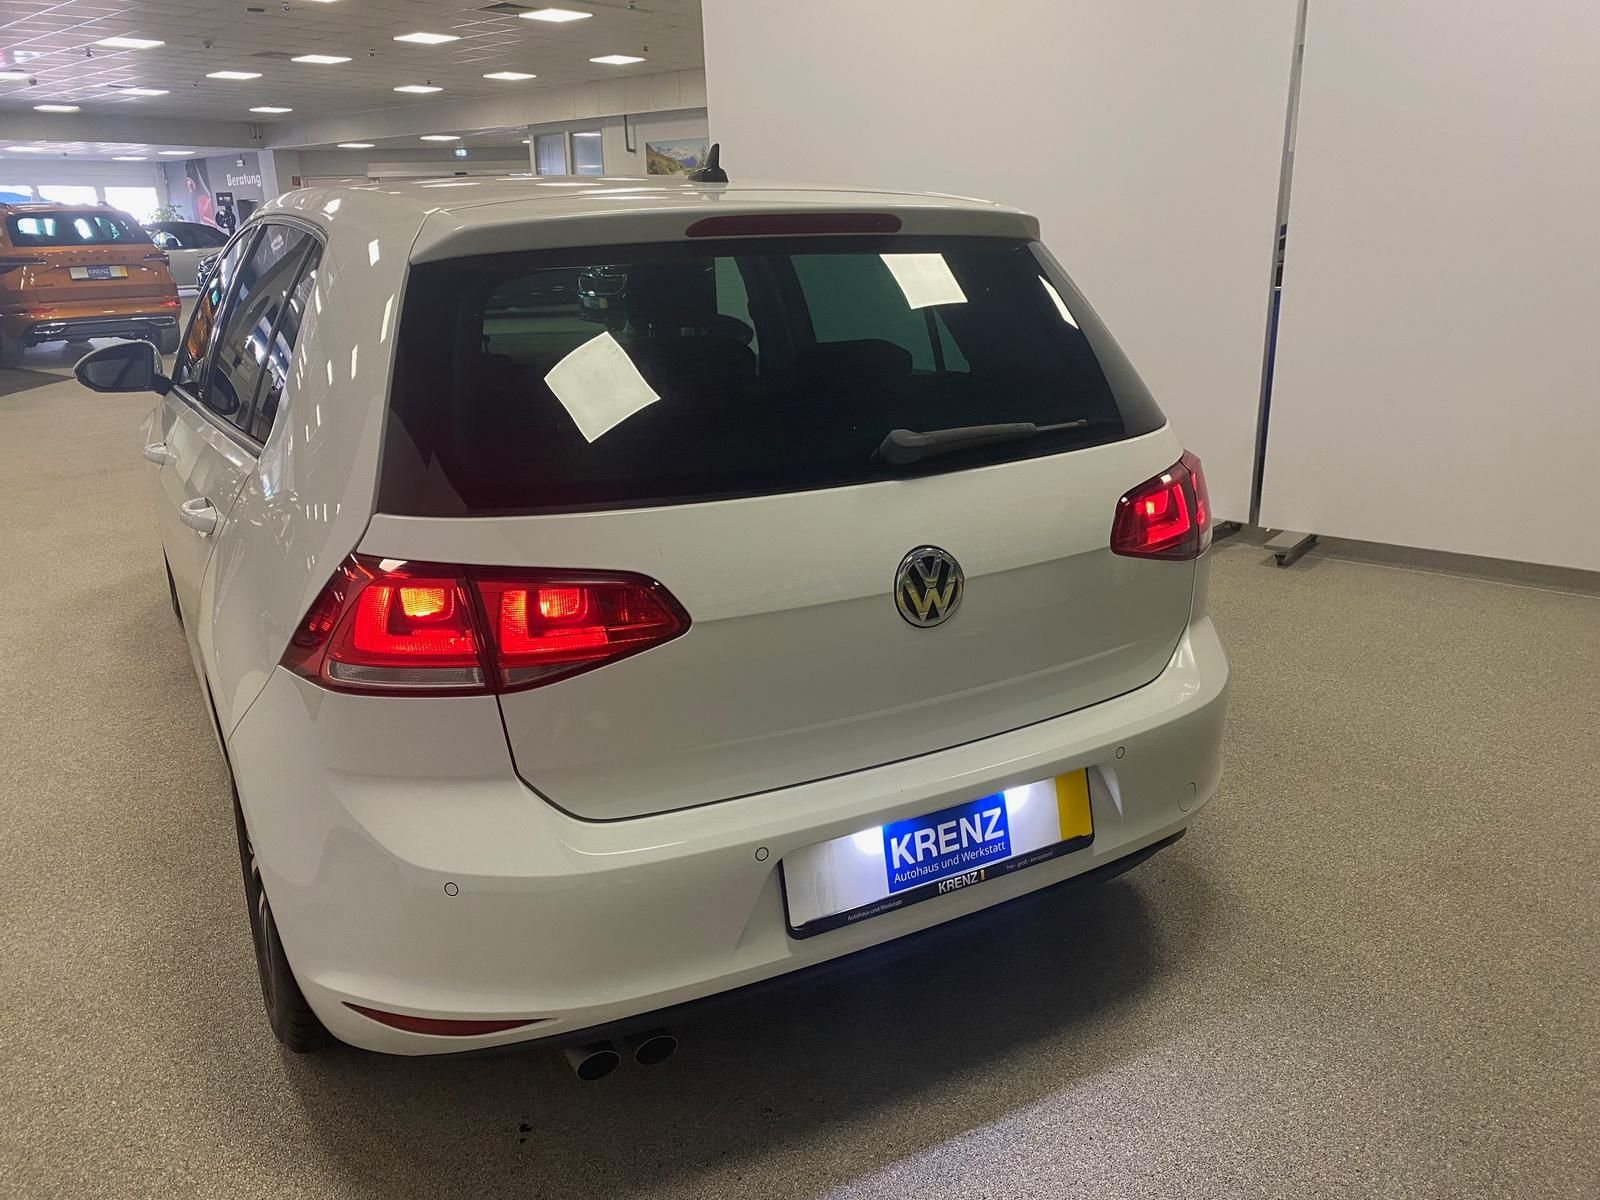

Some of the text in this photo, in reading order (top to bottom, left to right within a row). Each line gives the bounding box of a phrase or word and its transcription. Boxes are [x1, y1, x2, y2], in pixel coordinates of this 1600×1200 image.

[226, 173, 262, 187] Beratung
[890, 807, 1005, 870] KRENZ
[893, 861, 940, 884] Autohaus
[941, 855, 960, 869] und
[961, 841, 1006, 863] Werkstatt
[938, 871, 978, 894] KRENZ
